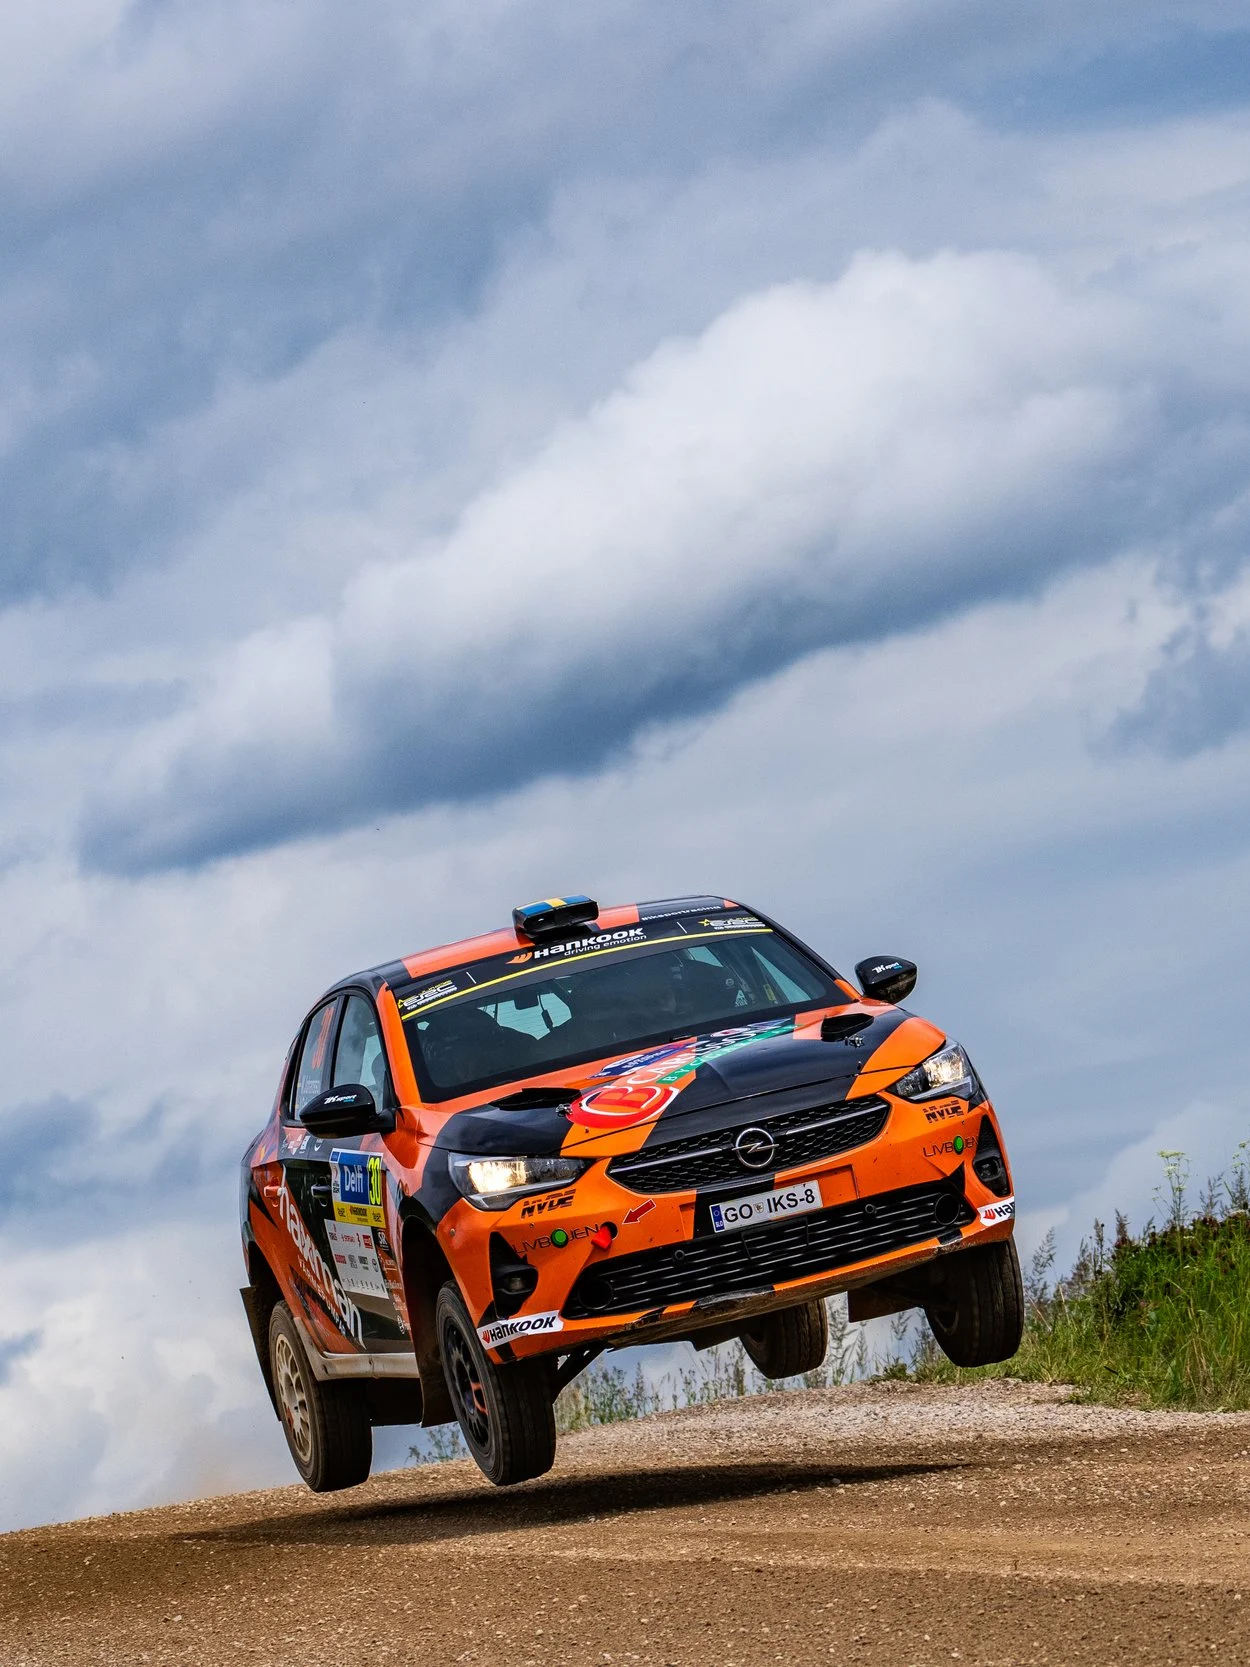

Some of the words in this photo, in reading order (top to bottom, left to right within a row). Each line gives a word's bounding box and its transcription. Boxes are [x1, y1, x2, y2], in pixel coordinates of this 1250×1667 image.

[564, 943, 601, 956] driving
[603, 934, 647, 947] emotion
[343, 1164, 364, 1193] Delfi
[368, 1156, 381, 1205] 30
[724, 1203, 753, 1223] GO
[766, 1188, 815, 1213] IKS-8
